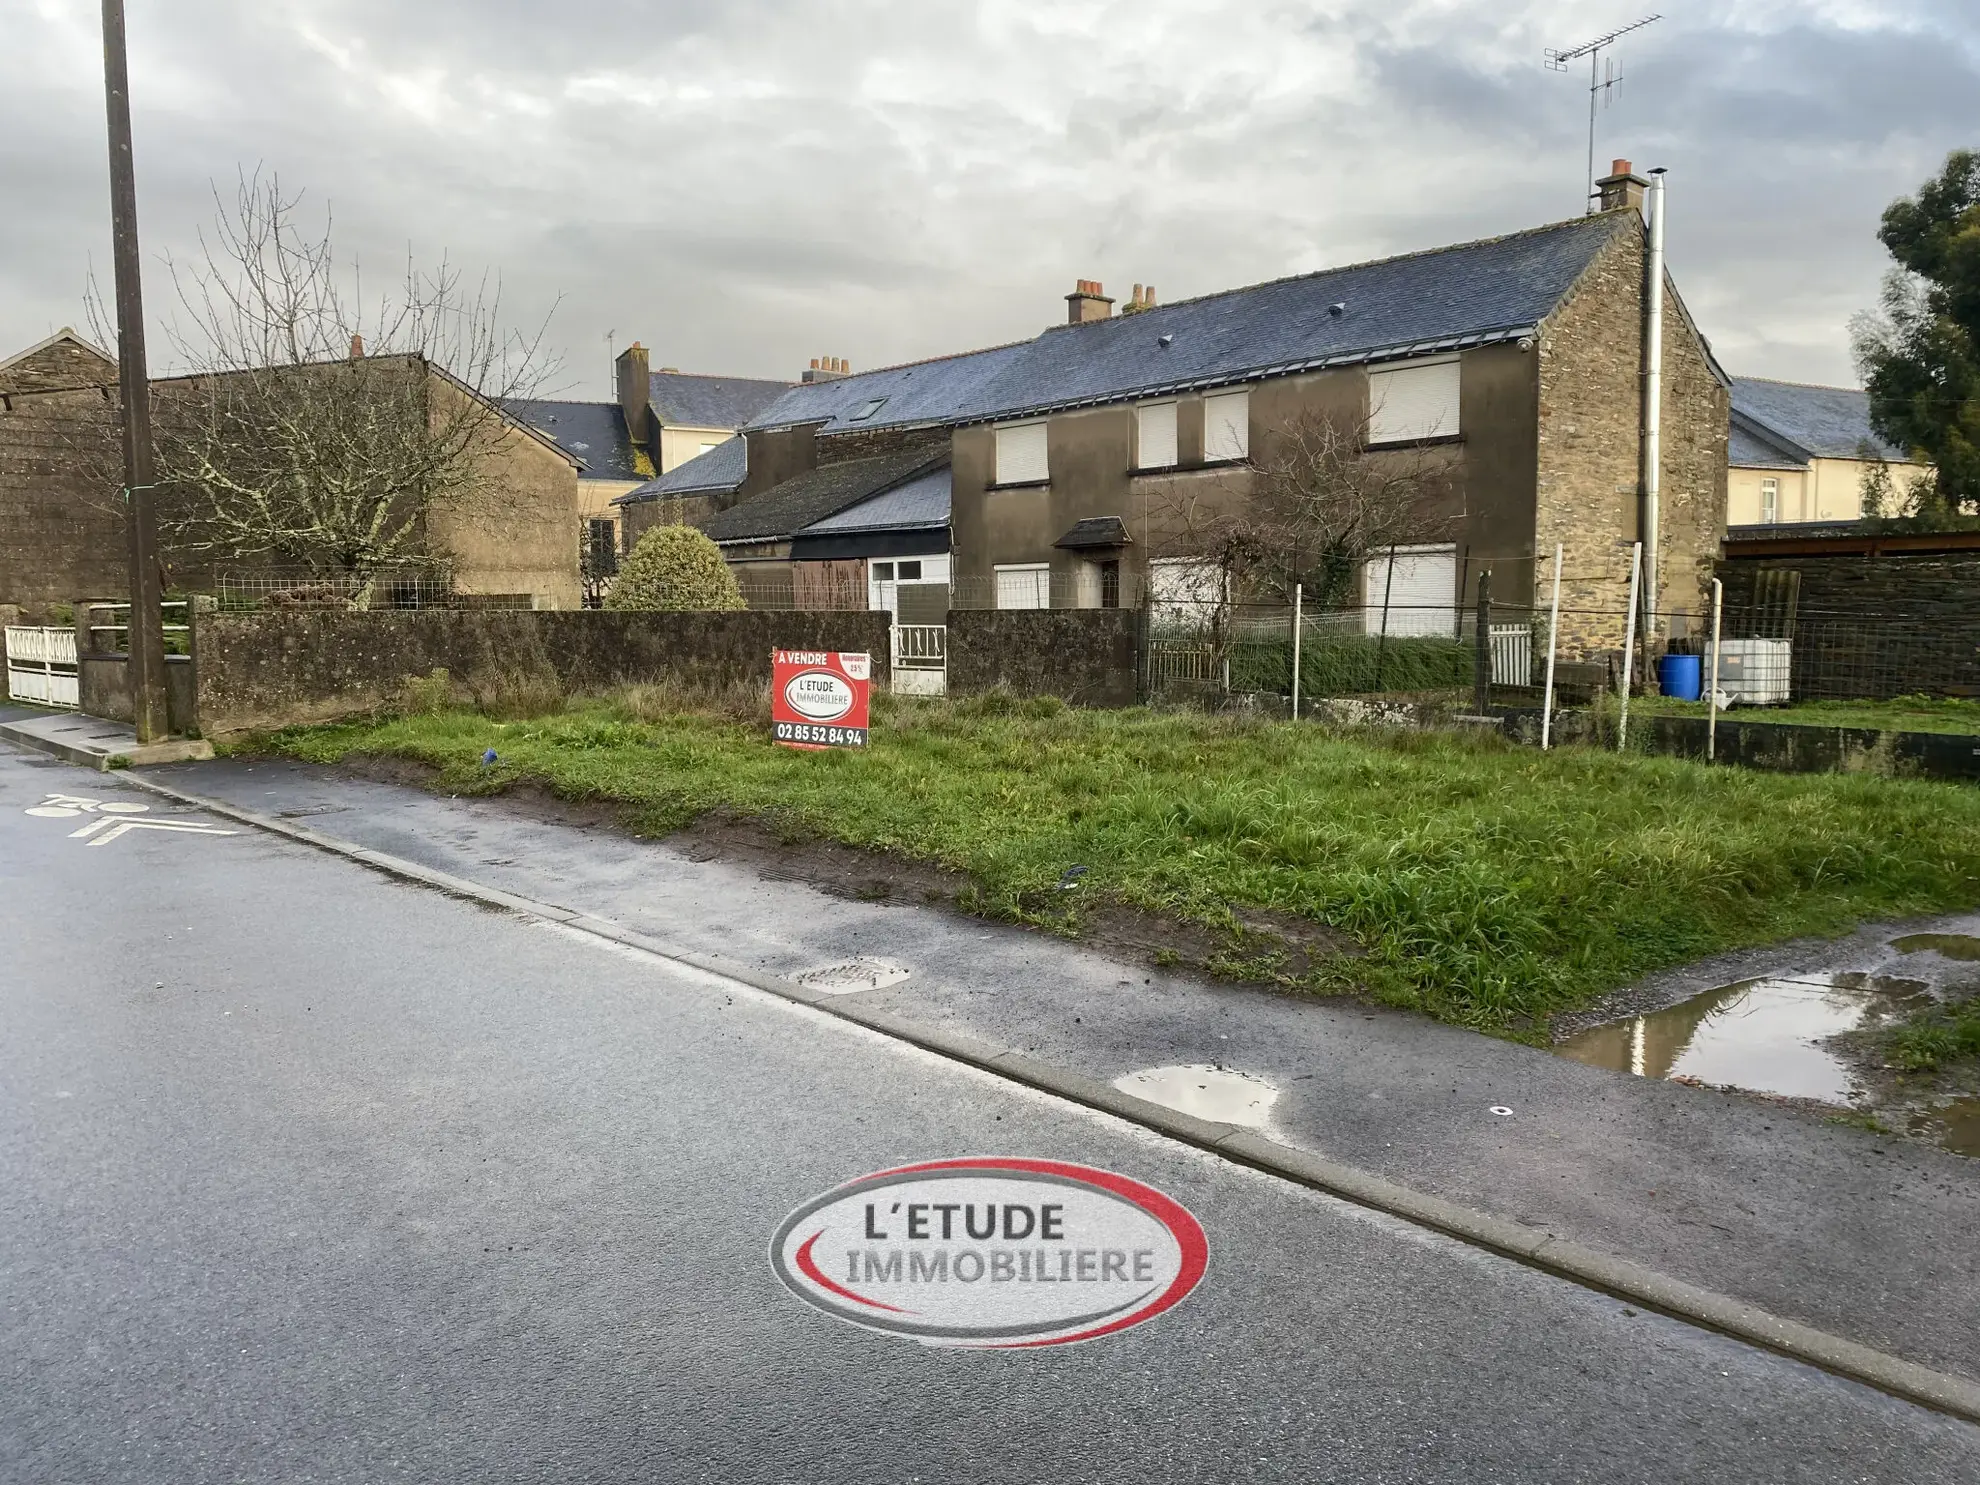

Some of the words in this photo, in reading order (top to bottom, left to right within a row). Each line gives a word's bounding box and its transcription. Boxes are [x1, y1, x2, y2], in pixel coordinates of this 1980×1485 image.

[778, 653, 786, 664] A
[787, 653, 828, 665] VENDRE
[799, 680, 834, 692] L'ETUDE
[796, 693, 848, 705] IMMOBILIERE
[777, 723, 792, 739] 02
[794, 725, 809, 740] 85
[811, 726, 826, 742] 52
[828, 728, 843, 744] 84
[846, 730, 862, 745] 94
